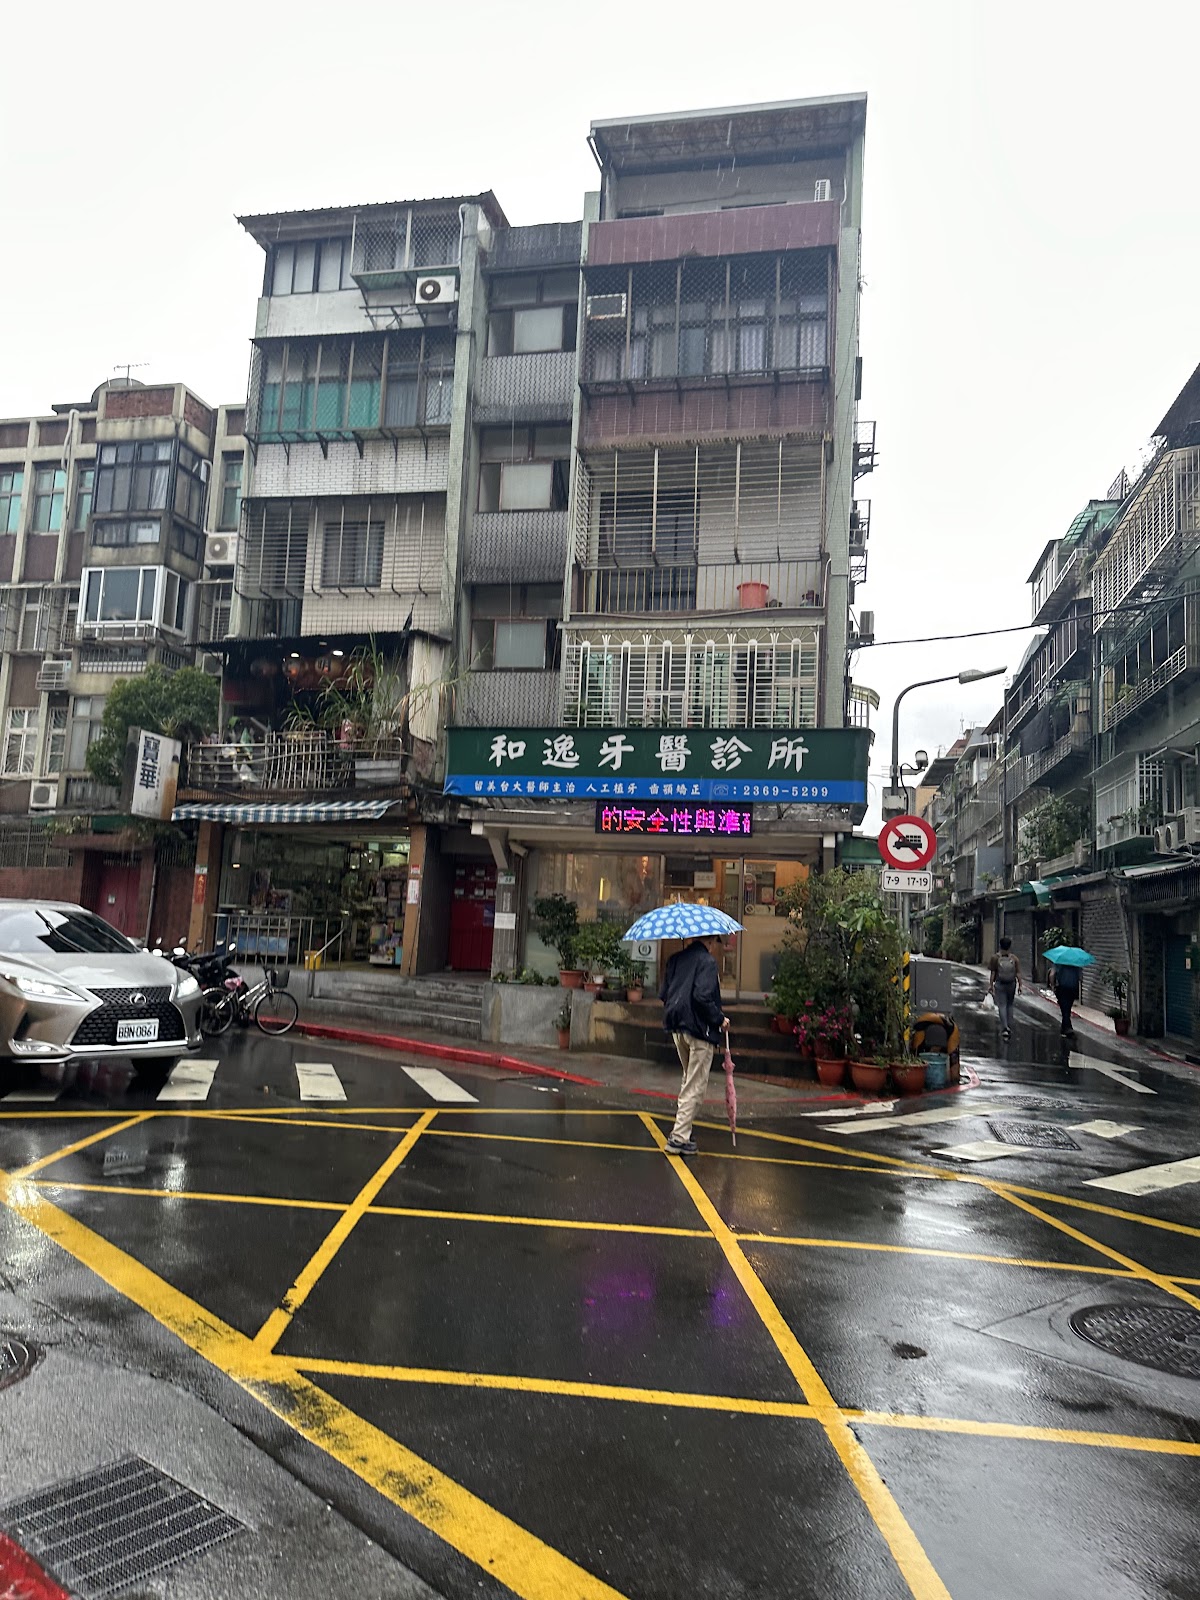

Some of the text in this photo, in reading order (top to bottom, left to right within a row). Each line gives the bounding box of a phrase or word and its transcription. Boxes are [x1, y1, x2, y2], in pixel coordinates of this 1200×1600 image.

[488, 733, 810, 773] 和逸牙醫診所
[586, 782, 638, 795] 人工植牙
[886, 876, 928, 887] 7-9 17-19
